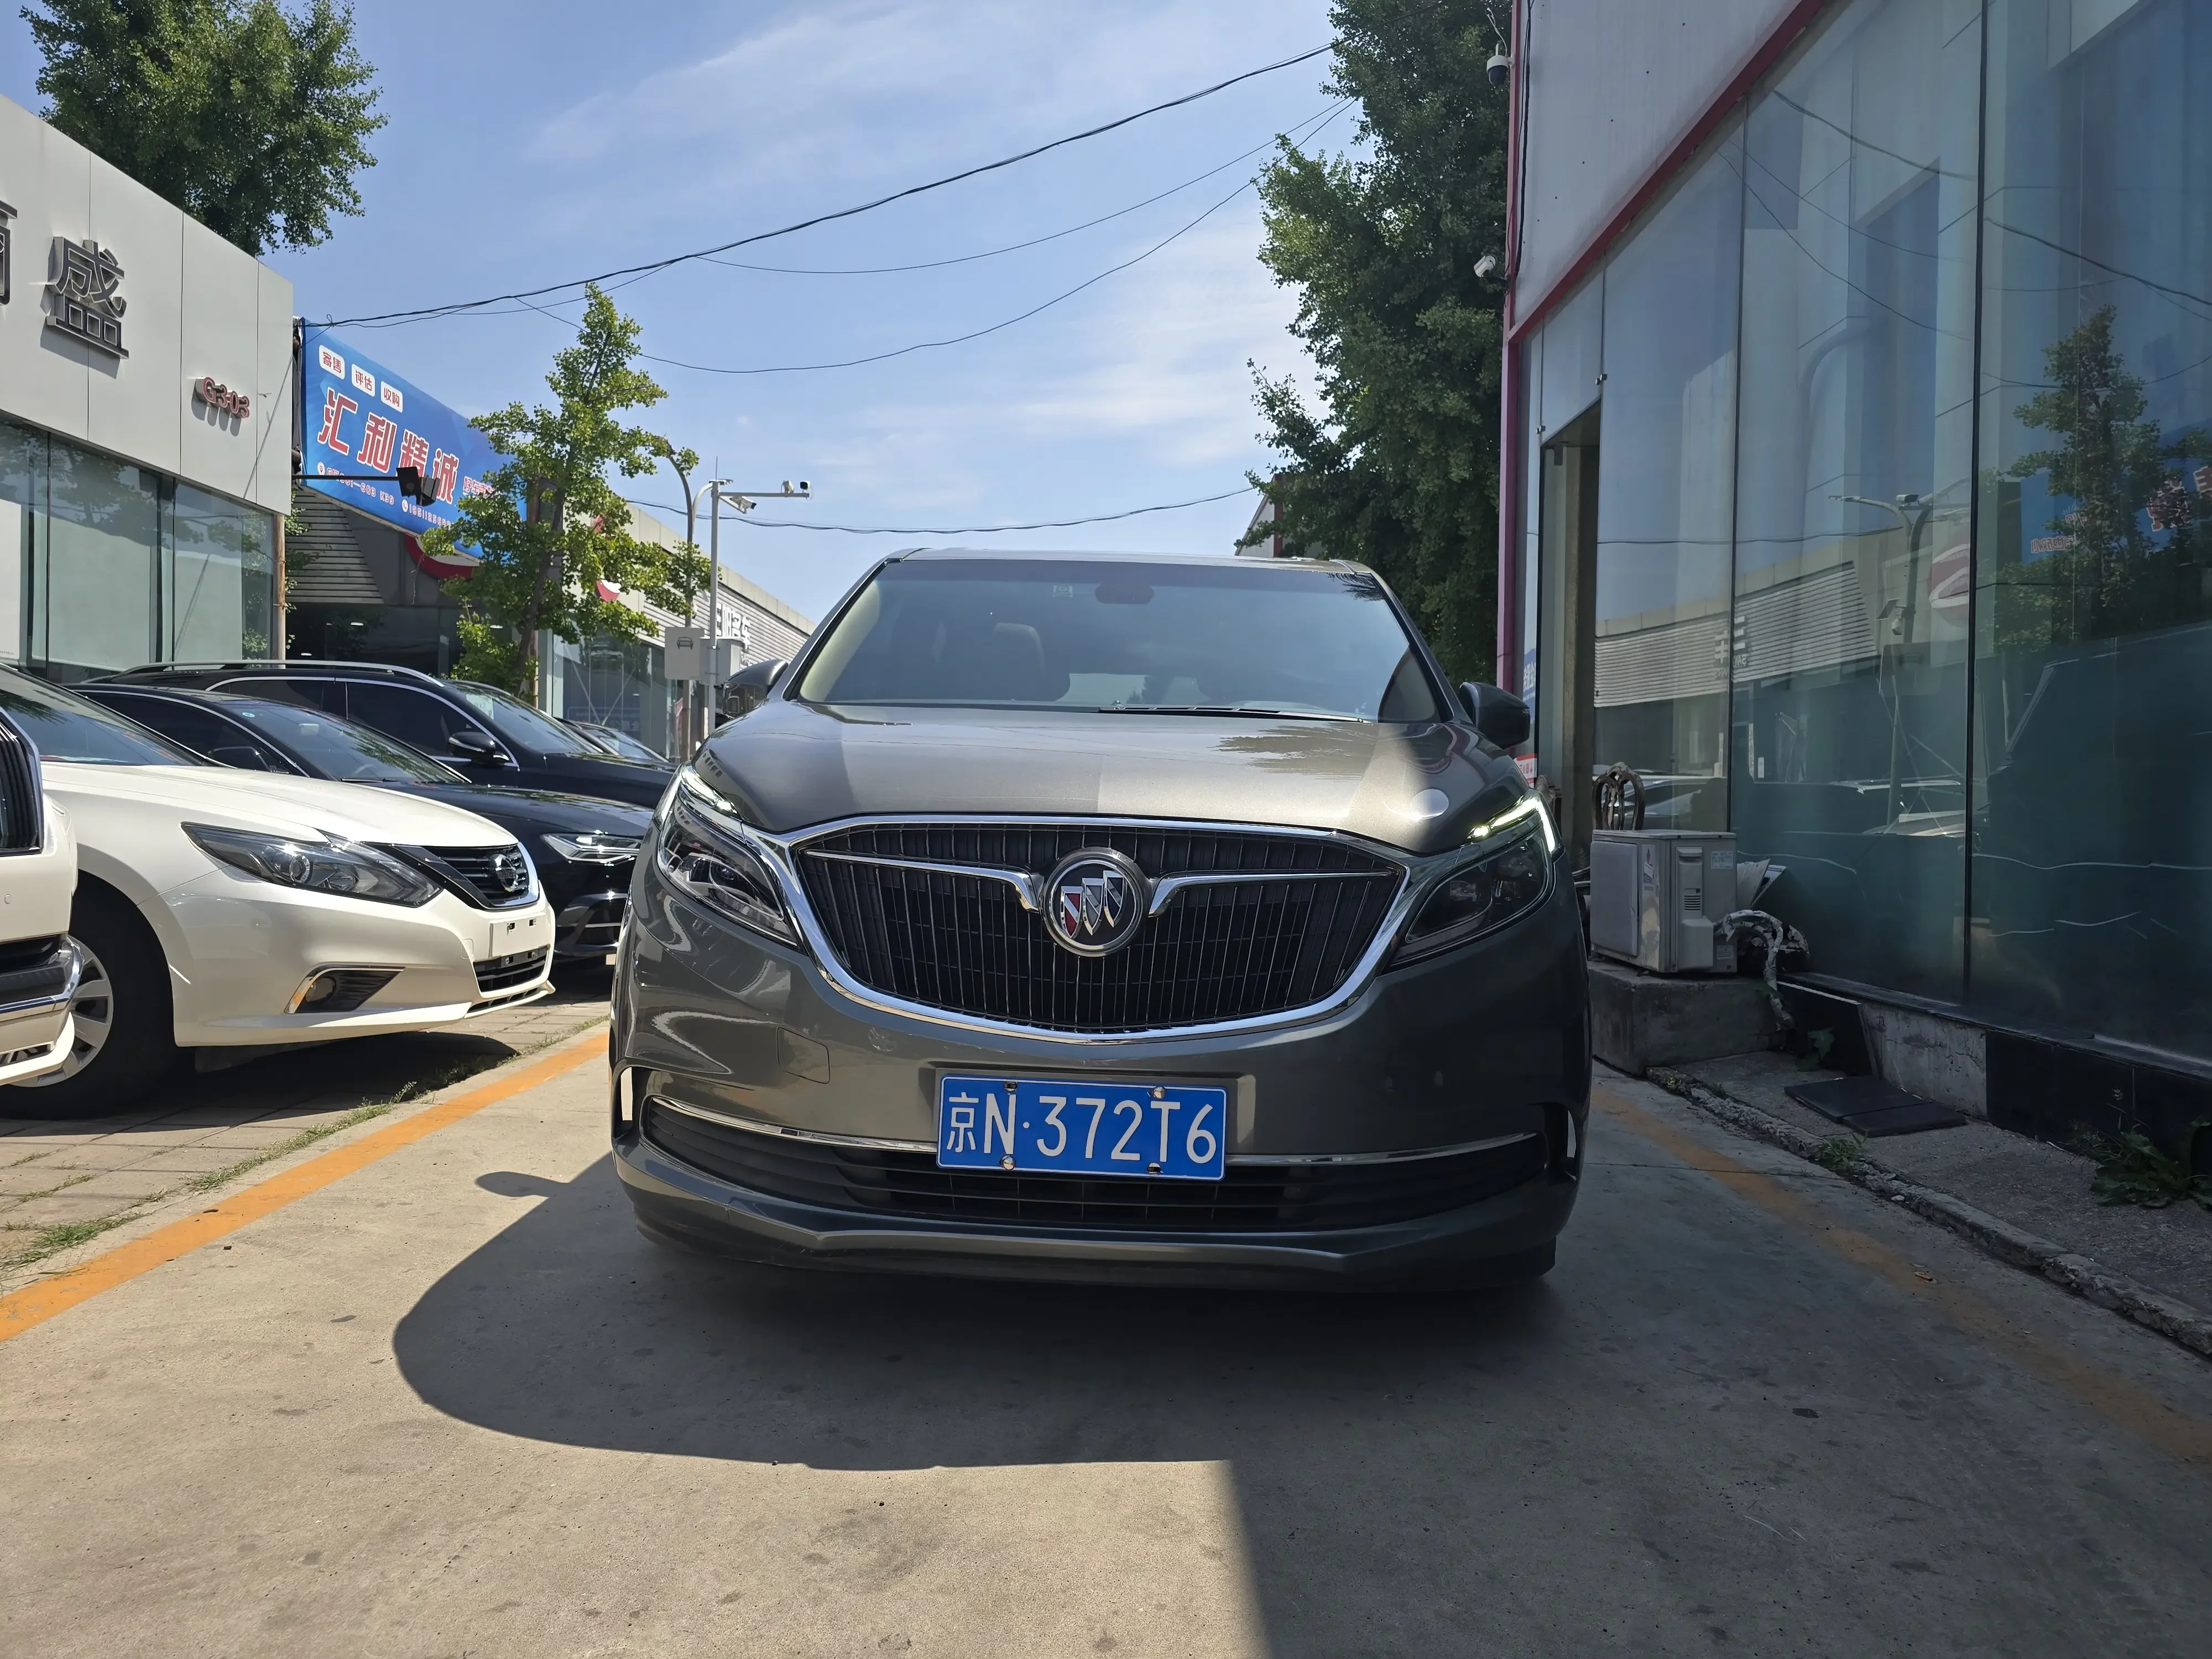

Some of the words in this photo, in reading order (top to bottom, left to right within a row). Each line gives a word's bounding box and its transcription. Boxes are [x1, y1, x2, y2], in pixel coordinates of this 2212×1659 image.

[199, 377, 250, 419] G303
[323, 351, 342, 373] 寄售
[355, 370, 372, 392] 评估
[384, 387, 400, 407] 收购
[317, 387, 460, 504] 汇利精诚
[946, 1092, 1217, 1165] 京N·372T6
